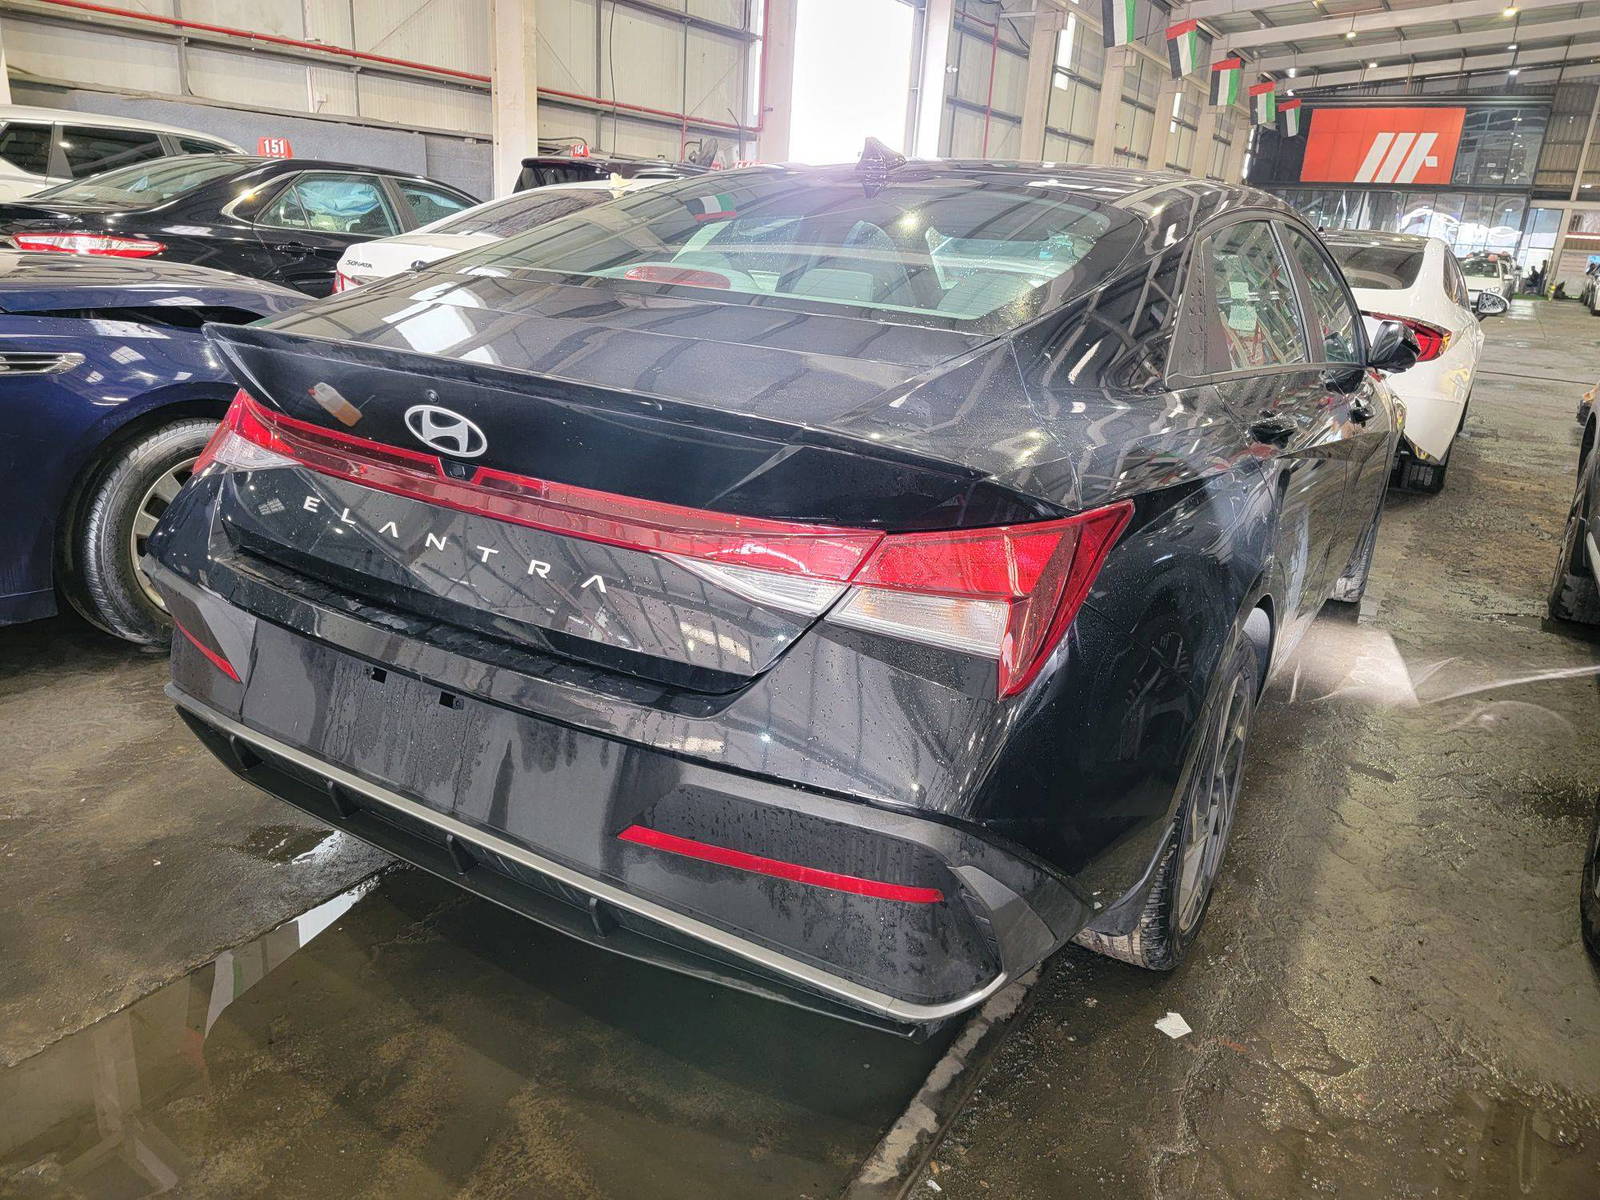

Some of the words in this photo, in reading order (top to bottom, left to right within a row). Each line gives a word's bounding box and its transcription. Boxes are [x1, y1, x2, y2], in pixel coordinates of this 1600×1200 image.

[263, 139, 285, 154] 151
[346, 259, 373, 268] SONATA
[303, 495, 607, 593] ELANTRA
